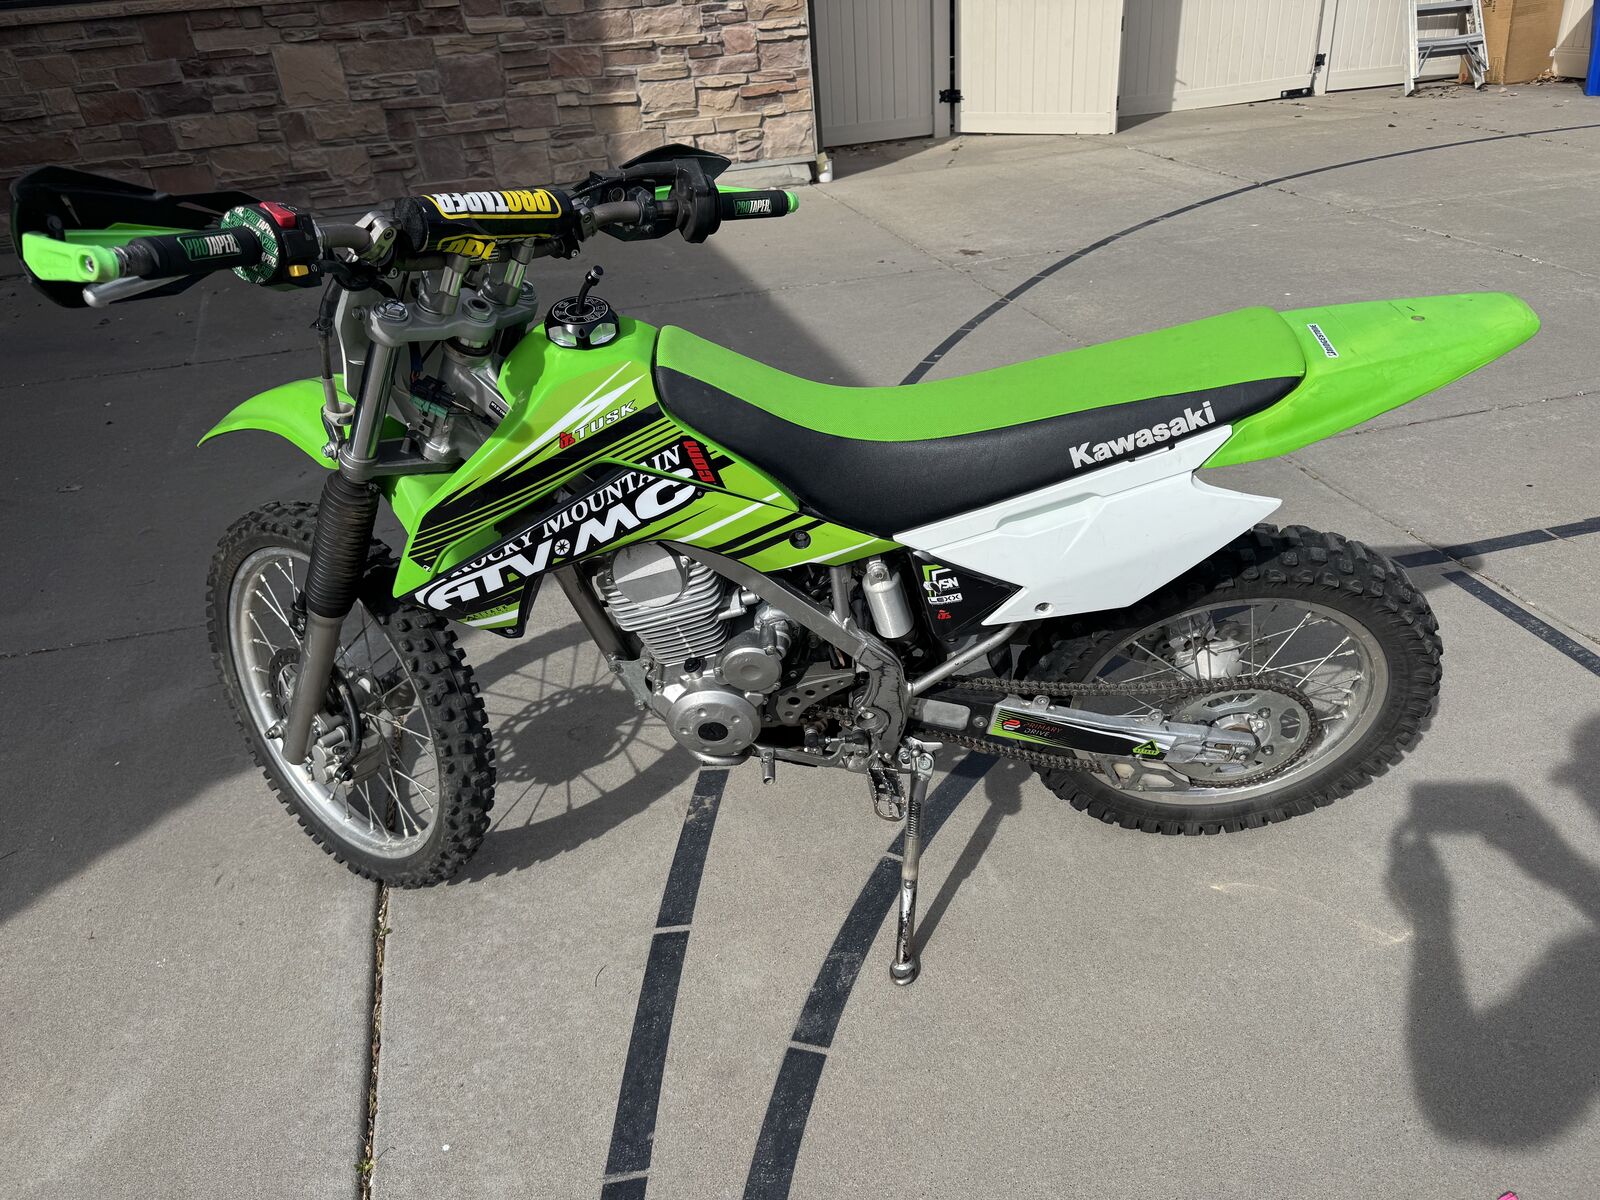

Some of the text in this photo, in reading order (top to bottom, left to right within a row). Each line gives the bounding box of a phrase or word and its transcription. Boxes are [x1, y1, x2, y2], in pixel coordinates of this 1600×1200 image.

[432, 188, 551, 213] PROTAPER
[575, 399, 637, 440] TUSK
[1068, 400, 1216, 469] Kawasaki
[542, 444, 681, 539] MOUNTAIN
[573, 467, 697, 557] MC
